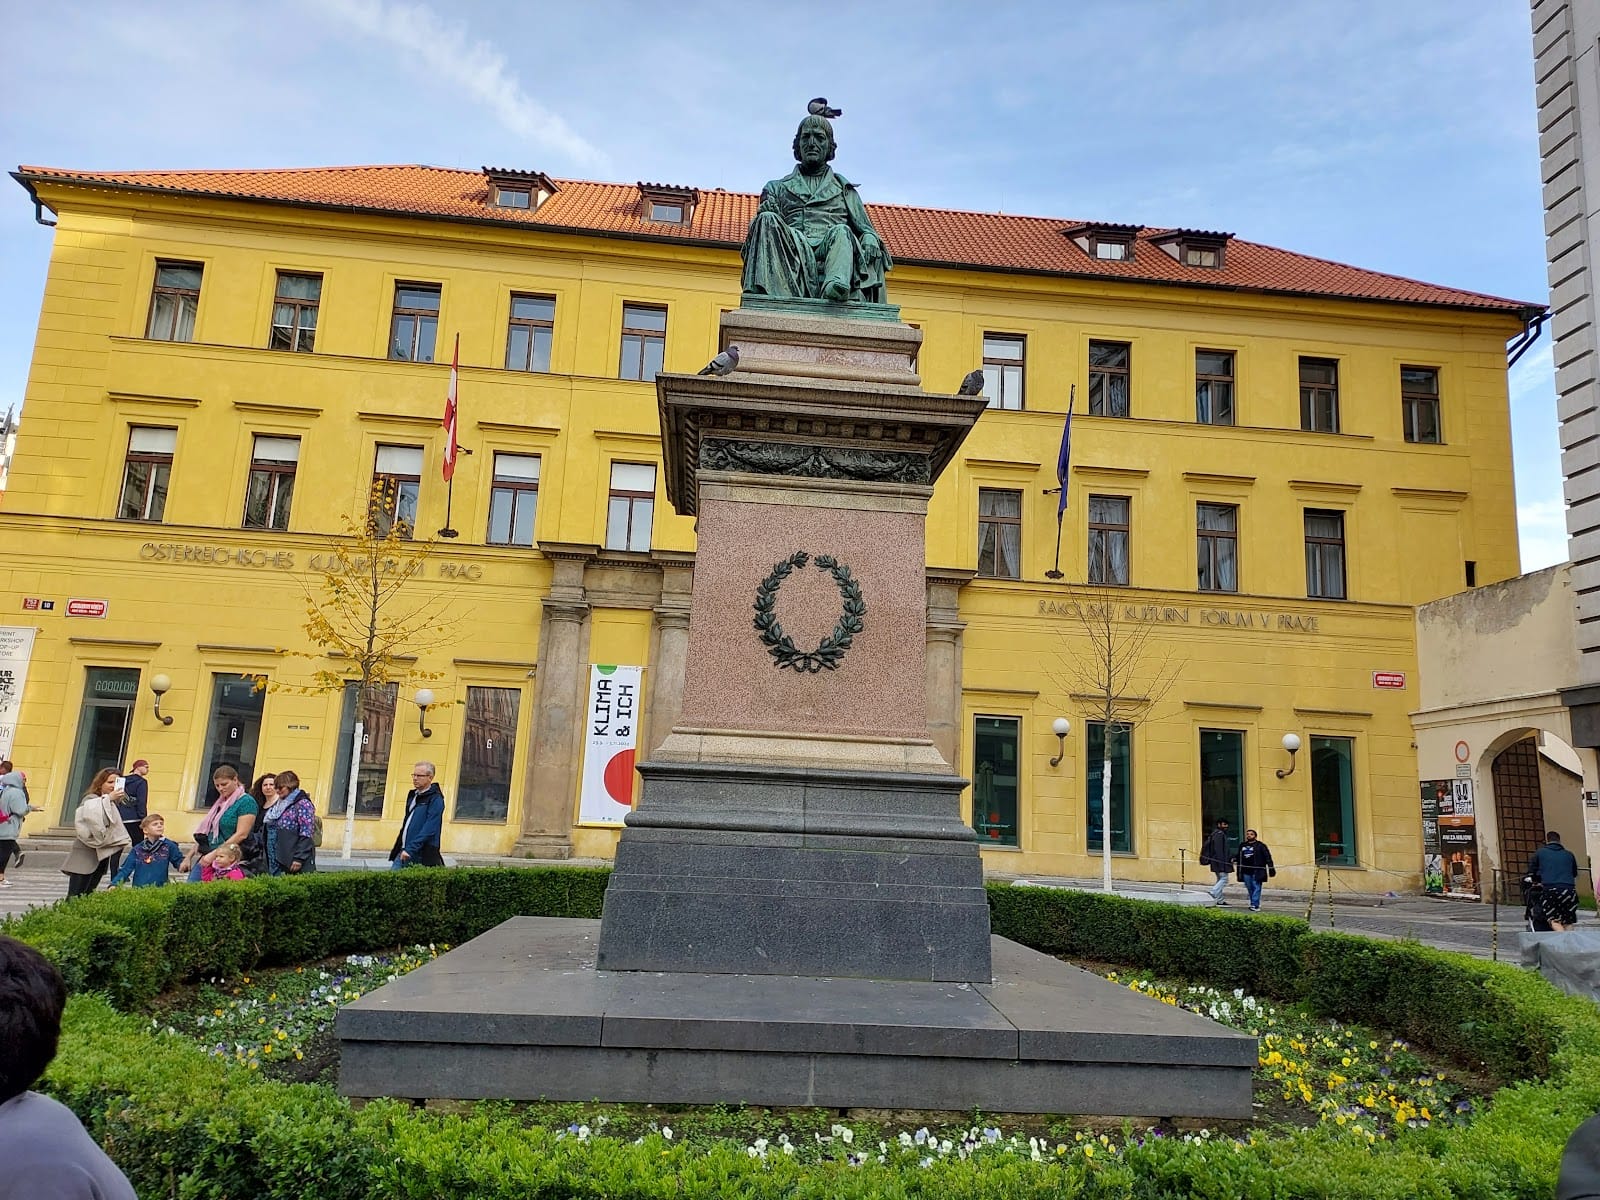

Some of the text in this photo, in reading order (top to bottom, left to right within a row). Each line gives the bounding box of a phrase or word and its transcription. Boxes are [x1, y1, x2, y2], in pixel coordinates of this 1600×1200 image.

[139, 542, 295, 569] ÖSTERREICHISCHES
[440, 562, 483, 580] PRAG
[1260, 612, 1271, 628] V
[593, 679, 612, 736] KLIMA
[616, 685, 633, 719] ICH
